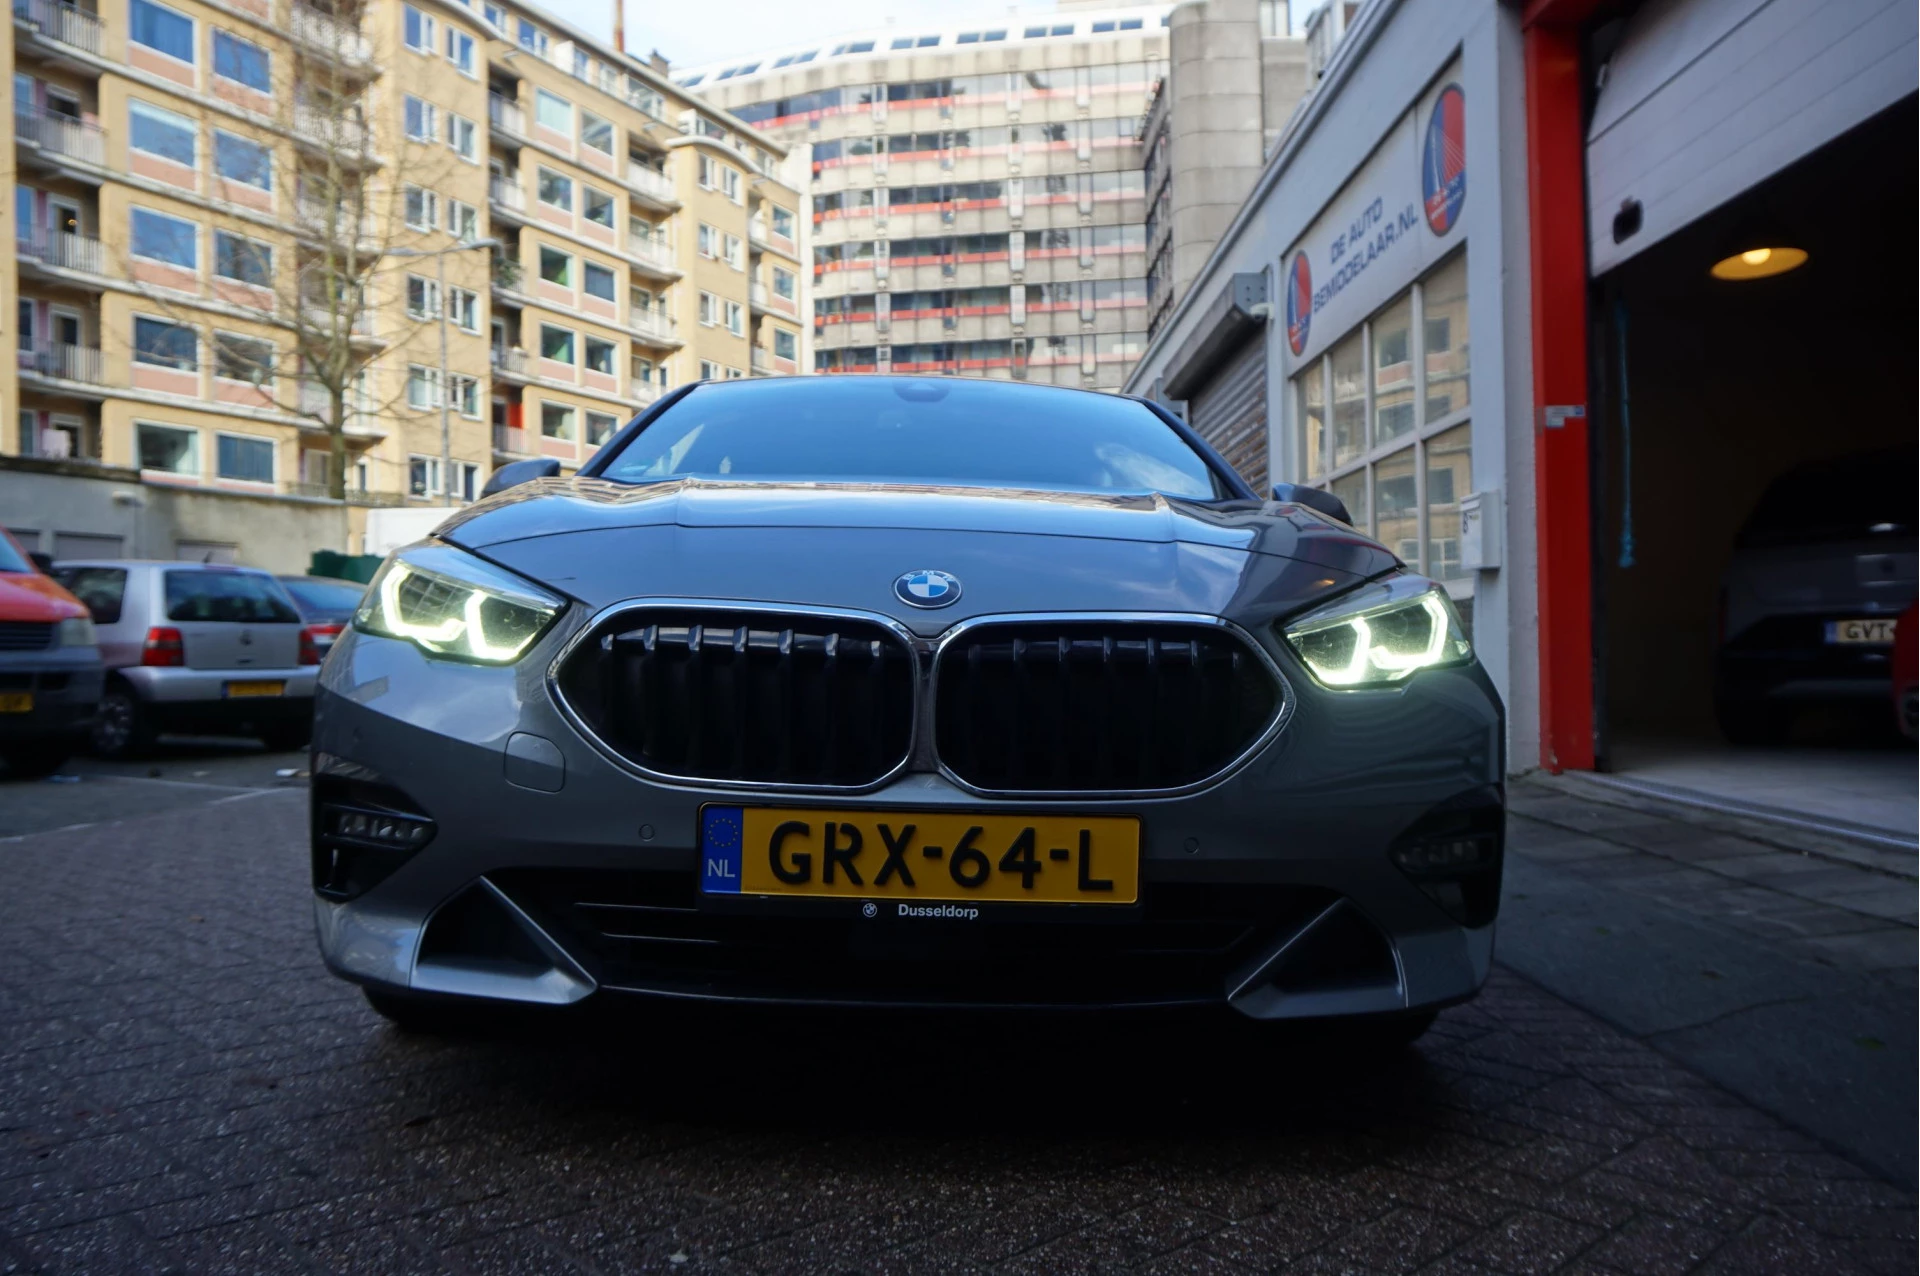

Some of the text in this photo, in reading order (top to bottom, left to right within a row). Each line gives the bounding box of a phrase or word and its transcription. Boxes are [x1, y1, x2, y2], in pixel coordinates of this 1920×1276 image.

[1313, 203, 1418, 314] BEMIDDELAAR.NL
[1331, 233, 1346, 264] DE
[1348, 196, 1383, 247] AUTO
[707, 858, 735, 877] NL
[768, 820, 1113, 892] GRX-64-L
[898, 903, 979, 920] Dusseldorp
